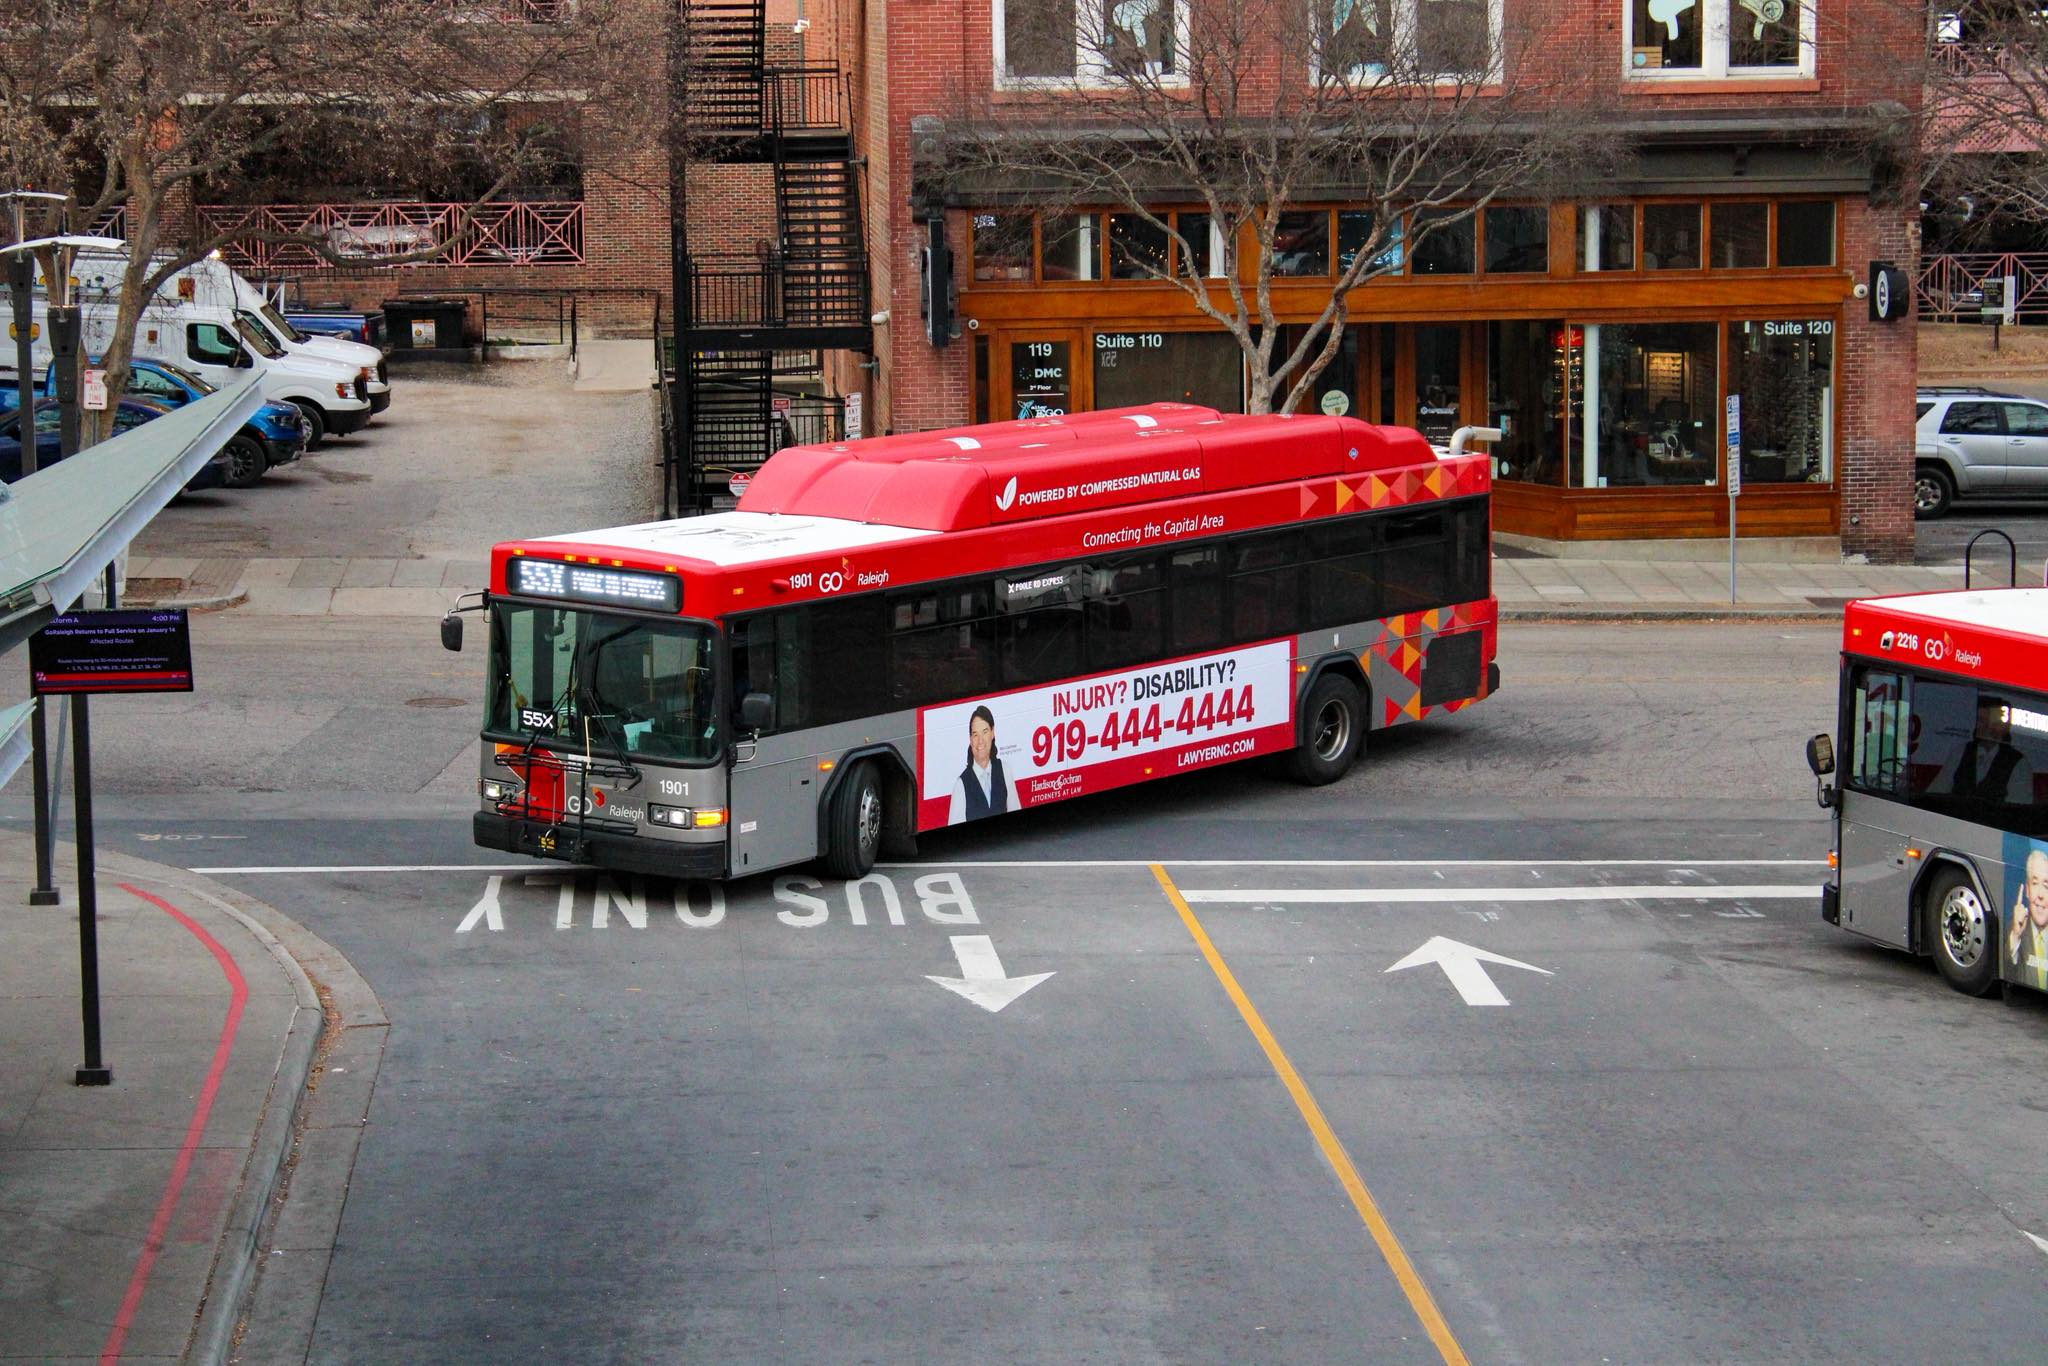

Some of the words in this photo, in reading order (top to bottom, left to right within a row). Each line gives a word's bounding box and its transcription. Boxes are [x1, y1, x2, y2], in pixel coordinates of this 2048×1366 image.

[1764, 321, 1803, 335] Suite
[1806, 321, 1832, 335] 120
[1028, 343, 1052, 357] 119
[1096, 334, 1134, 348] Suite
[1139, 334, 1162, 348] 110
[1034, 368, 1062, 378] DMC
[1019, 488, 1064, 506] POWERED
[1067, 486, 1079, 498] BY
[1080, 475, 1140, 496] COMPRESSED
[1140, 469, 1181, 485] NATURAL
[1182, 466, 1200, 480] GAS
[1083, 526, 1141, 547] Connecting
[1144, 522, 1161, 538] the
[1163, 515, 1199, 537] Capital
[1201, 514, 1224, 529] Area
[790, 573, 812, 589] 1901
[819, 572, 842, 592] GO
[858, 569, 889, 586] Raleigh
[1897, 632, 1918, 650] 2216
[1925, 638, 1943, 660] GO
[1955, 649, 1982, 669] Raleigh
[1053, 680, 1128, 717] INJURY?
[1133, 658, 1236, 700] DISABILITY?
[522, 710, 554, 728] 55X
[1032, 684, 1255, 767] 919-444-4444
[2001, 706, 2009, 723] 3
[1177, 738, 1255, 767] LAWYERNC.COM
[660, 779, 689, 796] 1901
[1031, 790, 1060, 803] ATTORNEYS
[1071, 786, 1082, 794] LAW
[568, 796, 593, 814] GO
[610, 804, 644, 821] Raleigh
[455, 874, 728, 934] ONLY
[774, 872, 981, 928] BUS
